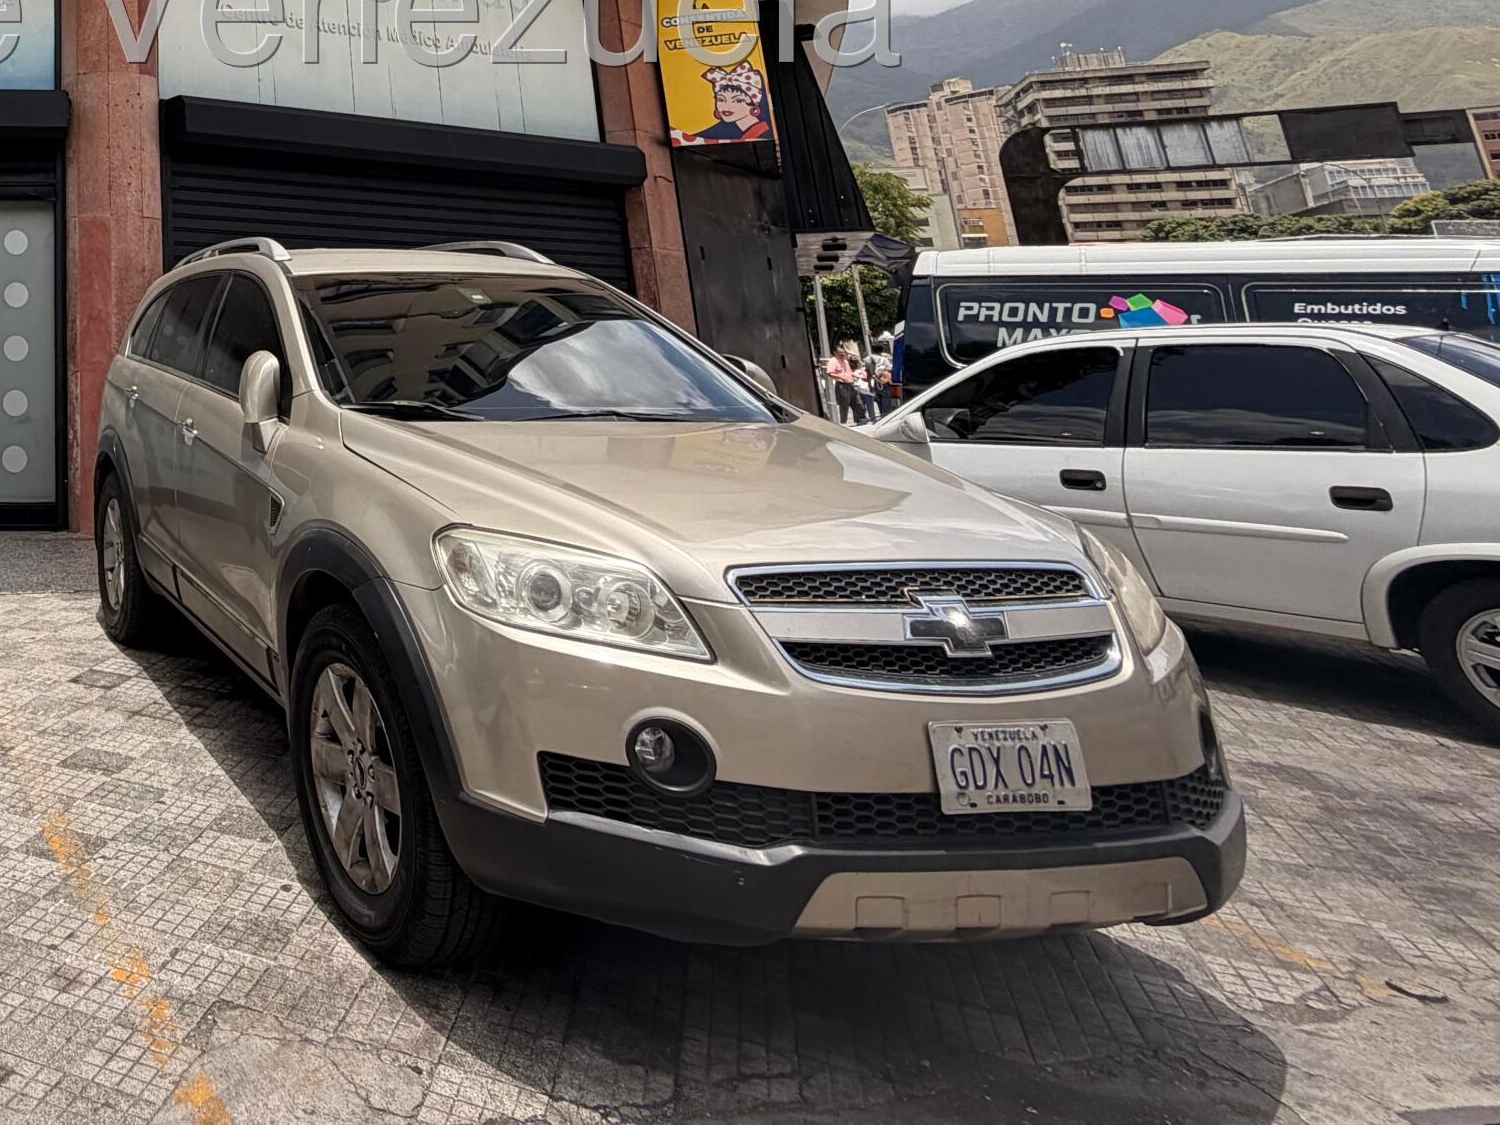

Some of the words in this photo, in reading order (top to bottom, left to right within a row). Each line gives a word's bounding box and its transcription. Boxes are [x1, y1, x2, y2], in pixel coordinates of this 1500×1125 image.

[697, 25, 713, 34] DE
[665, 32, 752, 50] VENEZUELA
[957, 302, 1097, 323] PRONTO
[1293, 302, 1407, 314] Embutidos
[972, 729, 1039, 742] VENEZUELA
[950, 744, 1008, 790] GDX
